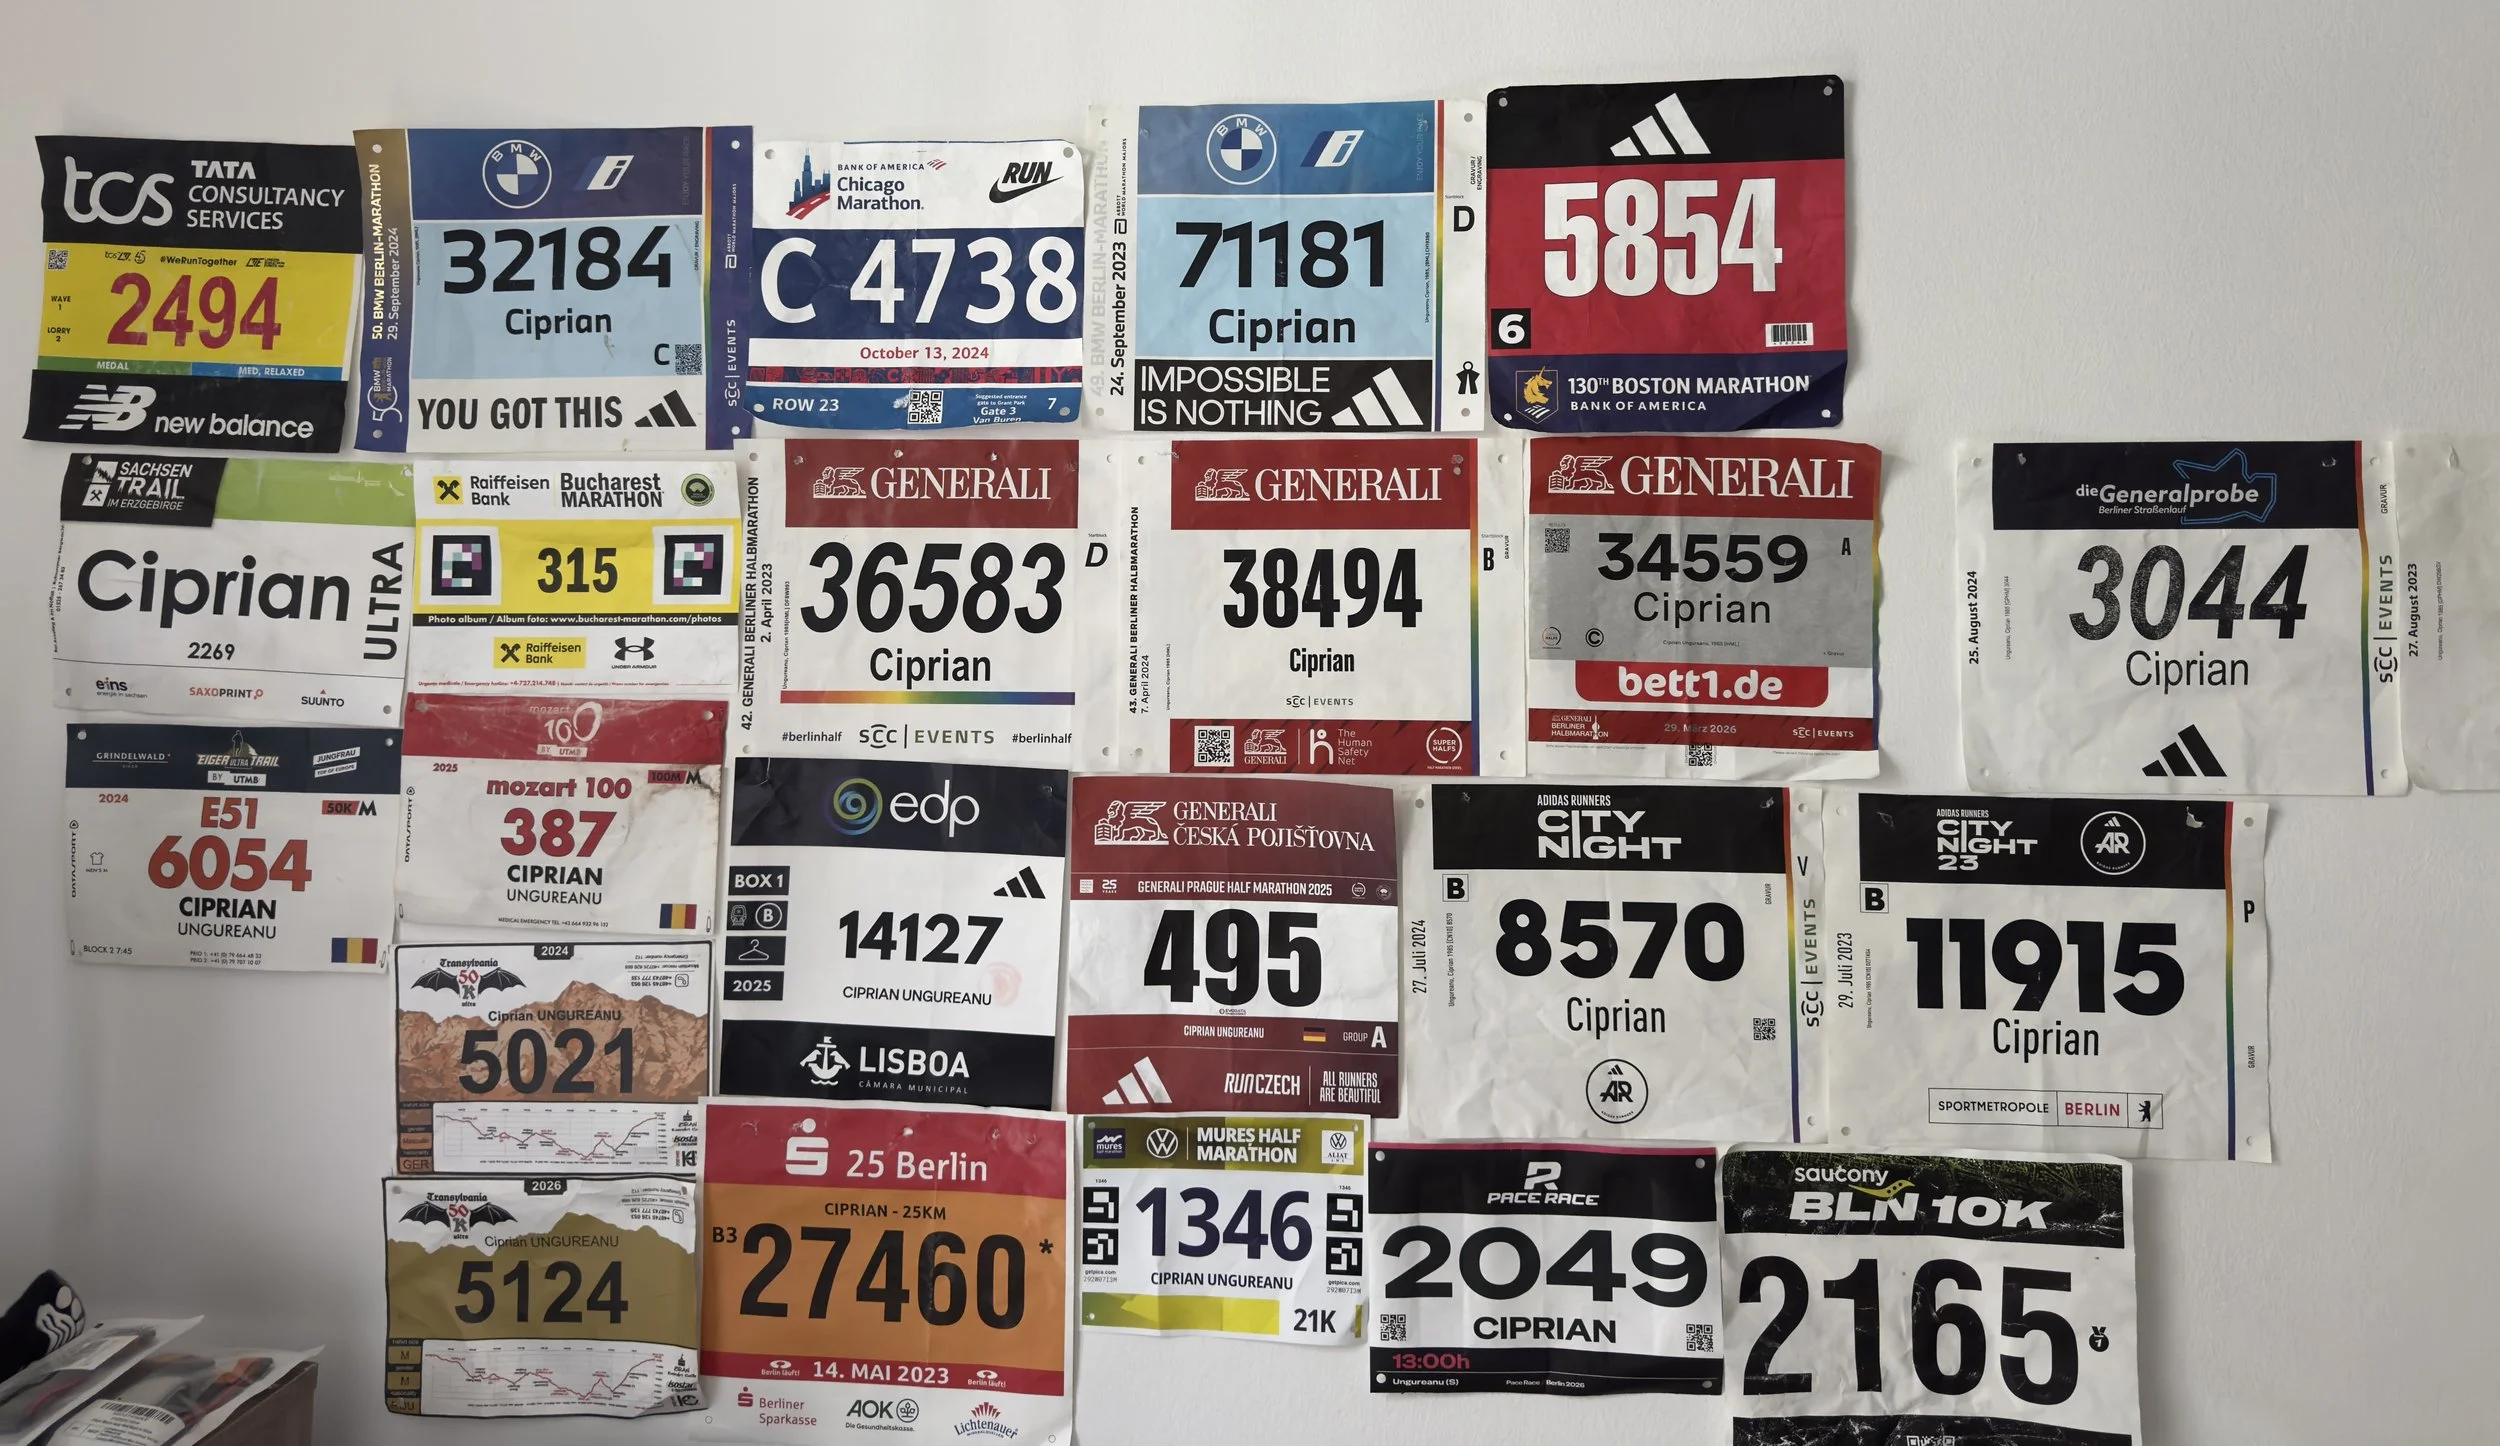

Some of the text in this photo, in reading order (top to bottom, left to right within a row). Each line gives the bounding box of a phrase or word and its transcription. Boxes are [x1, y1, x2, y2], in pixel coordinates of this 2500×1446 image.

[191, 160, 256, 179] TATA
[188, 185, 345, 207] CONSULTANCY
[838, 177, 905, 195] Chicago
[187, 209, 284, 230] SERVICES
[1544, 178, 1783, 297] 5854
[160, 256, 237, 267] #WeRunTogether
[370, 164, 383, 340] 50. BMW BERLIN-MARATHON
[443, 226, 671, 293] 32184
[1175, 219, 1384, 288] 71181
[761, 236, 1077, 324] C 4738
[107, 272, 282, 350] 2494
[1110, 241, 1126, 396] 24. September 2023
[506, 308, 612, 340] Ciprian
[1209, 309, 1356, 351] Ciprian
[1498, 314, 1525, 344] 6
[97, 362, 129, 370] MEDAL
[1141, 367, 1330, 392] IMPOSSIBLE
[1612, 377, 1691, 394] BOSTON
[1696, 376, 1810, 393] MARATHON
[418, 395, 623, 429] YOU GOT THIS
[981, 407, 1006, 415] Gate
[1141, 400, 1322, 425] IS NOTHING
[1571, 401, 1707, 411] BANK OF AMERICA
[155, 413, 314, 438] new balance
[120, 463, 193, 478] SACHSEN
[560, 473, 661, 491] Bucharest
[1620, 455, 1855, 499] GENERALI
[117, 477, 185, 500] TRAIL
[471, 476, 550, 490] Raiffeisen
[871, 467, 1052, 500] GENERALI
[1254, 467, 1442, 502] GENERALI
[107, 498, 183, 511] IM ERZGEBIRGE
[471, 493, 510, 506] Bank
[561, 491, 663, 507] MARATHON
[2099, 505, 2187, 514] Berliner Straßenlauf
[1598, 532, 1809, 584] 34559
[537, 547, 618, 594] 315
[78, 549, 350, 628] Ciprian
[800, 541, 1066, 634] 36583
[1223, 547, 1423, 629] 38494
[2069, 544, 2310, 641] 3044
[363, 542, 404, 660] ULTRA
[1633, 592, 1771, 628] Ciprian
[2409, 563, 2420, 657] 27. August 2023
[428, 615, 454, 623] Photo
[527, 615, 548, 623] foto:
[550, 615, 722, 624] www.bucharest-marathon.com/photos
[188, 642, 235, 660] 2269
[1290, 648, 1355, 678] Ciprian
[870, 647, 992, 689] Ciprian
[2126, 651, 2249, 695] Ciprian
[189, 687, 253, 699] SAXOPRINT
[1618, 666, 1783, 700] bett1.de
[301, 697, 345, 707] SUUNTO
[782, 731, 842, 742] #berlinhalf
[1012, 732, 1072, 744] #berlinhalf
[1338, 729, 1356, 738] The
[1338, 738, 1373, 747] Human
[97, 752, 166, 760] GRINDELWALD
[1338, 747, 1369, 758] Safety
[1338, 756, 1355, 766] Net
[433, 763, 458, 772] 2025
[99, 794, 129, 803] 2024
[487, 777, 632, 799] mozart 100
[889, 779, 980, 837] edp
[1173, 801, 1278, 822] GENERALI
[1537, 795, 1611, 806] ADIDAS RUNNERS
[201, 797, 258, 829] E51
[1537, 809, 1646, 833] CITY
[500, 807, 617, 857] 387
[1173, 823, 1375, 852] ČESKÁ POJIŠŤOVNA
[1538, 835, 1682, 860] NIGHT
[148, 835, 312, 892] 6054
[1937, 855, 1979, 871] 23
[735, 875, 783, 888] BOX 1
[1138, 880, 1333, 896] GENERALI PRAGUE HALF MARATHON 2025
[179, 896, 277, 920] CIPRIAN
[178, 922, 277, 939] UNGUREANU
[839, 910, 1004, 964] 14127
[1495, 898, 1745, 982] 8570
[541, 946, 569, 956] 2024
[1143, 908, 1322, 1007] 495
[1906, 917, 2185, 1016] 11915
[843, 986, 992, 1005] CIPRIAN UNGUREANU
[1566, 997, 1666, 1039] Ciprian
[1993, 1018, 2100, 1063] Ciprian
[459, 1027, 633, 1094] 5021
[859, 1046, 970, 1078] LISBOA
[859, 1079, 968, 1094] CÂMARA MUNICIPAL
[1938, 1101, 2120, 1117] SPORTMETROPOLE BERLIN
[1259, 1129, 1301, 1143] HALF
[847, 1150, 988, 1181] 25 Berlin
[1197, 1146, 1297, 1163] MARATHON
[532, 1181, 561, 1191] 2026
[1794, 1165, 1889, 1187] saucony
[1487, 1192, 1599, 1206] PACE RACE
[1789, 1191, 2053, 1229] BLN 10K
[1136, 1186, 1312, 1262] 1346
[485, 1235, 619, 1249] Ciprian UNGUREANU
[739, 1222, 1026, 1330] 27460
[1382, 1224, 1708, 1308] 2049
[454, 1260, 629, 1324] 5124
[1150, 1272, 1294, 1290] CIPRIAN UNGUREANU
[1294, 1309, 1336, 1333] 21K
[1473, 1316, 1617, 1343] CIPRIAN
[1739, 1255, 2079, 1406] 2165
[814, 1362, 949, 1384] 14. MAI 2023
[1392, 1353, 1470, 1370] 13:00h
[759, 1398, 805, 1410] Berliner
[846, 1399, 894, 1419] AOK
[759, 1414, 817, 1427] Sparkasse
